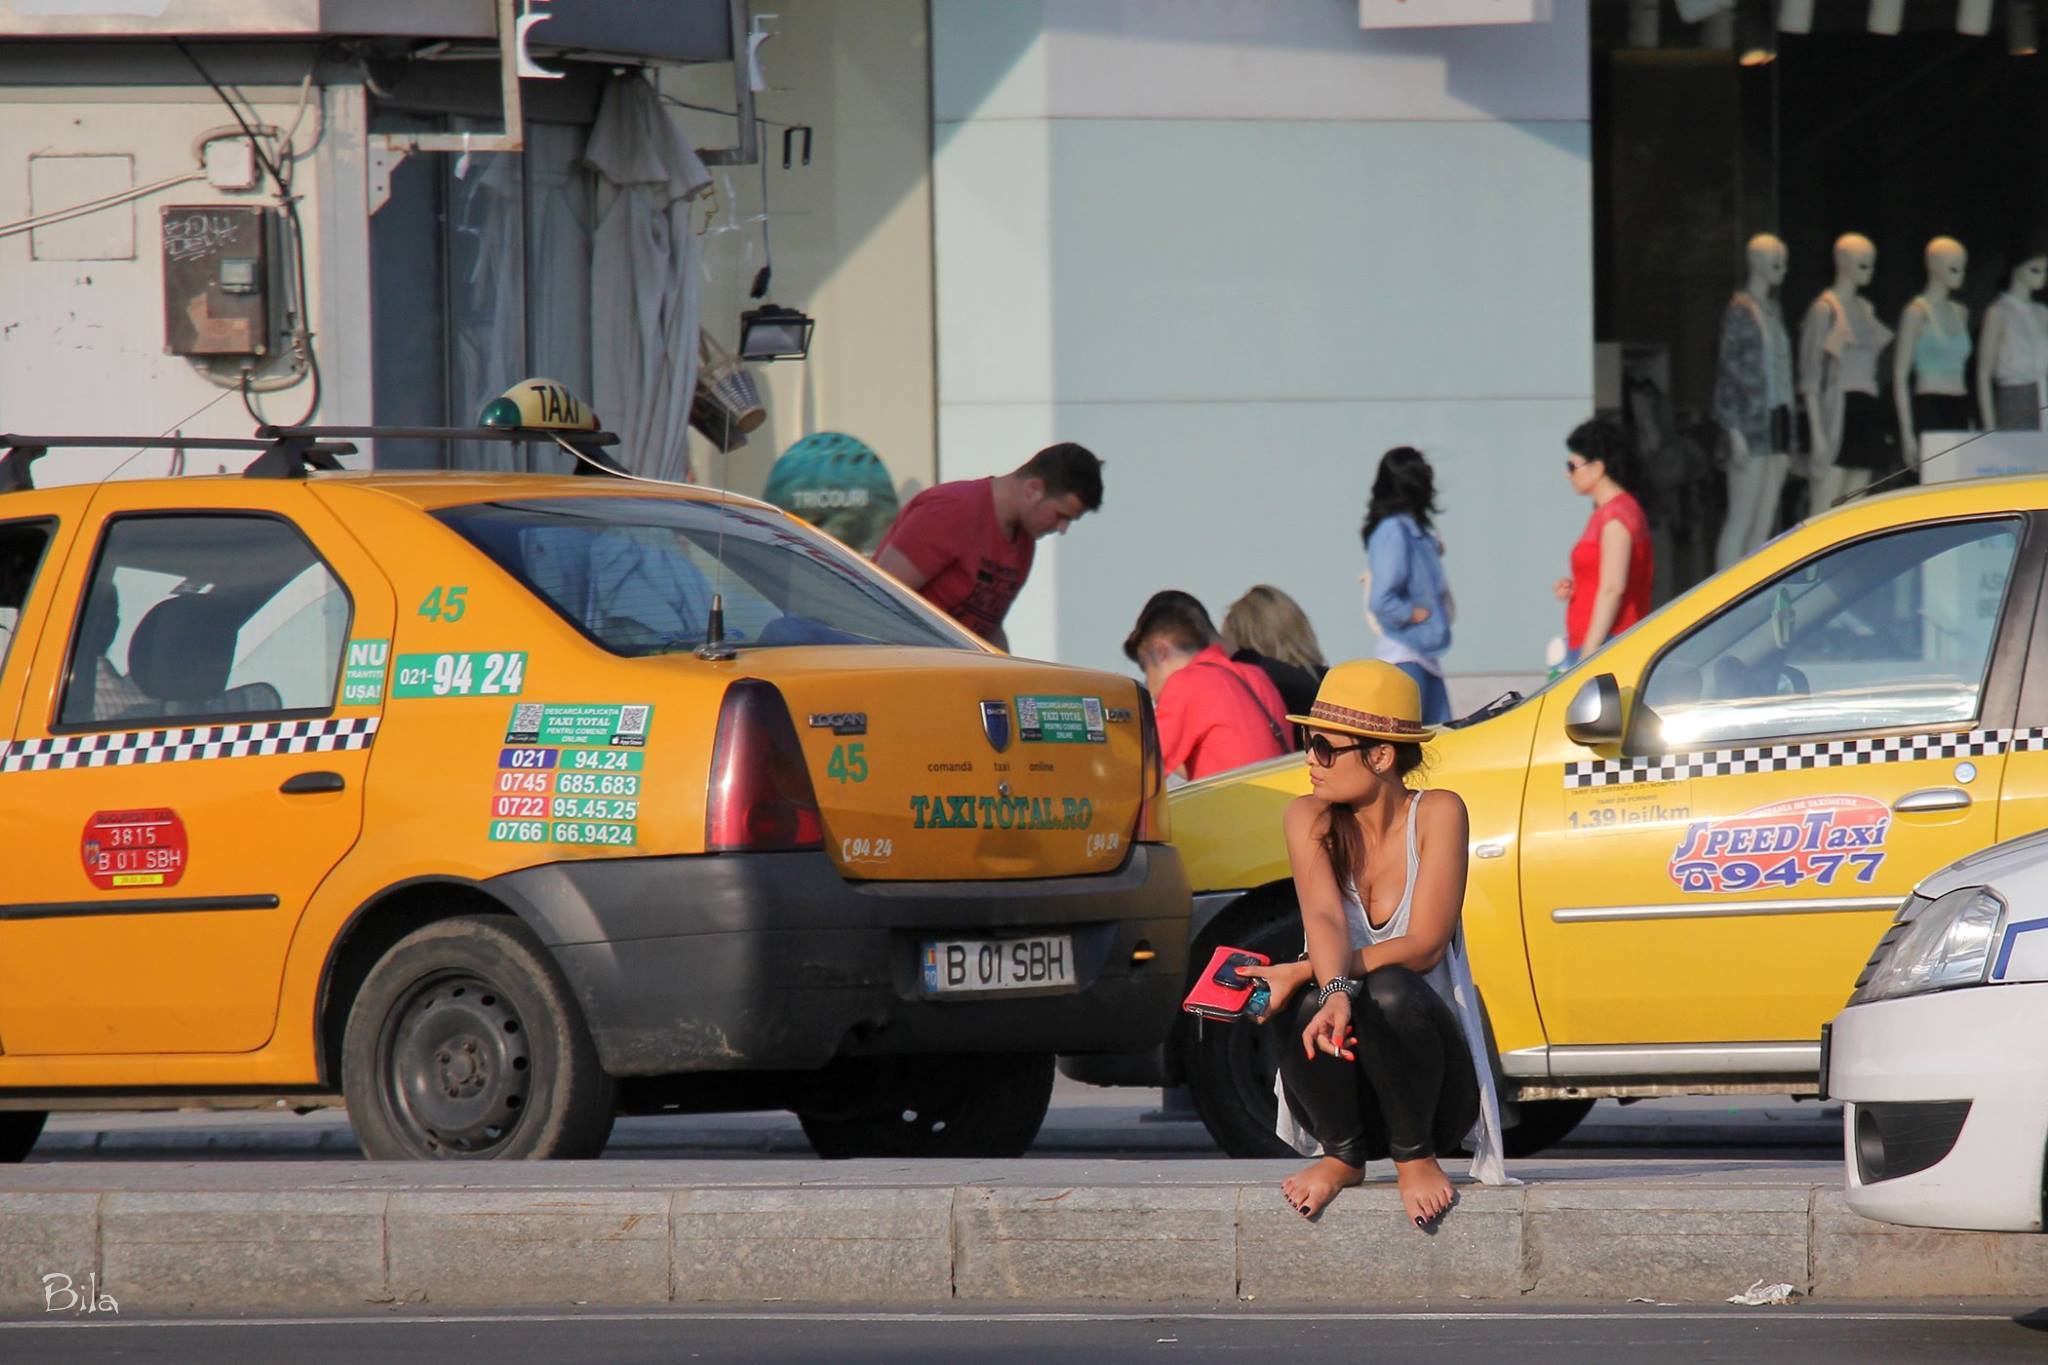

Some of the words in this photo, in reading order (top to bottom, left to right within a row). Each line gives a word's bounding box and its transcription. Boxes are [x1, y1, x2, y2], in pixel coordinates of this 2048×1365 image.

[530, 385, 579, 424] TAXI
[417, 586, 468, 622] 45
[349, 643, 388, 666] NU
[480, 653, 523, 694] 24
[548, 717, 574, 726] TAXI
[576, 717, 611, 727] TOTAL
[808, 713, 866, 728] LOGAN
[511, 750, 546, 767] 021
[575, 751, 628, 770] 94.24
[828, 743, 869, 784] 45
[994, 762, 1010, 772] taxi
[1029, 761, 1055, 772] online
[500, 773, 546, 792] 0745
[559, 774, 636, 795] 685.683
[498, 797, 544, 816] 0722
[1568, 808, 1616, 830] 1.39
[1621, 804, 1690, 825] lei/km
[111, 827, 156, 846] 3815
[495, 822, 542, 840] 0766
[556, 824, 633, 845] 66.9424
[852, 838, 871, 857] 94
[873, 839, 892, 857] 24
[98, 853, 111, 871] B
[117, 852, 137, 870] 01
[146, 849, 180, 869] SBH
[1721, 853, 1885, 889] 9477
[947, 945, 966, 986] B
[978, 944, 1003, 984] 01
[1012, 941, 1064, 982] SBH
